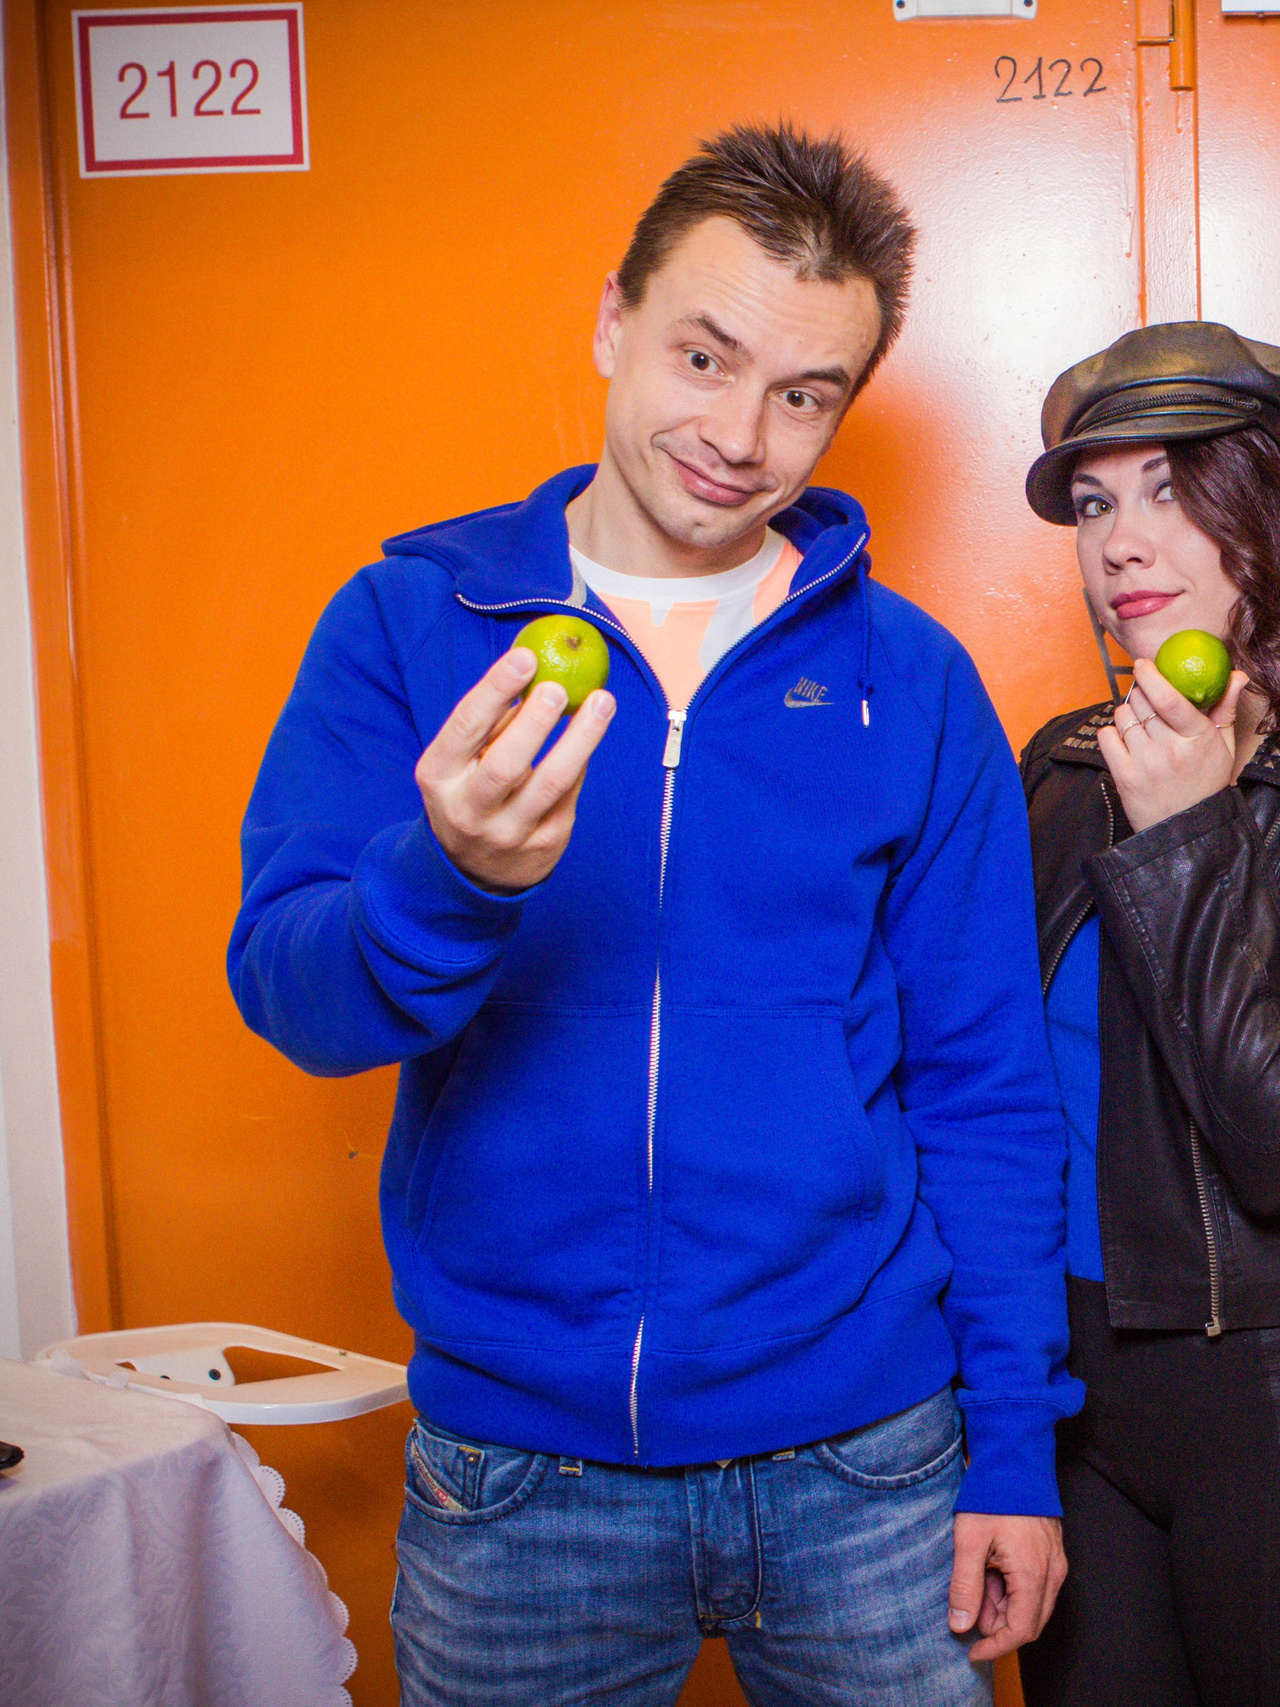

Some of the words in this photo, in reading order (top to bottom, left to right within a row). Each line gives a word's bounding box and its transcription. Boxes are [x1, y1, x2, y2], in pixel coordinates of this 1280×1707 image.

[118, 58, 261, 119] 2122
[994, 55, 1107, 103] 2122
[794, 675, 829, 703] NIKE
